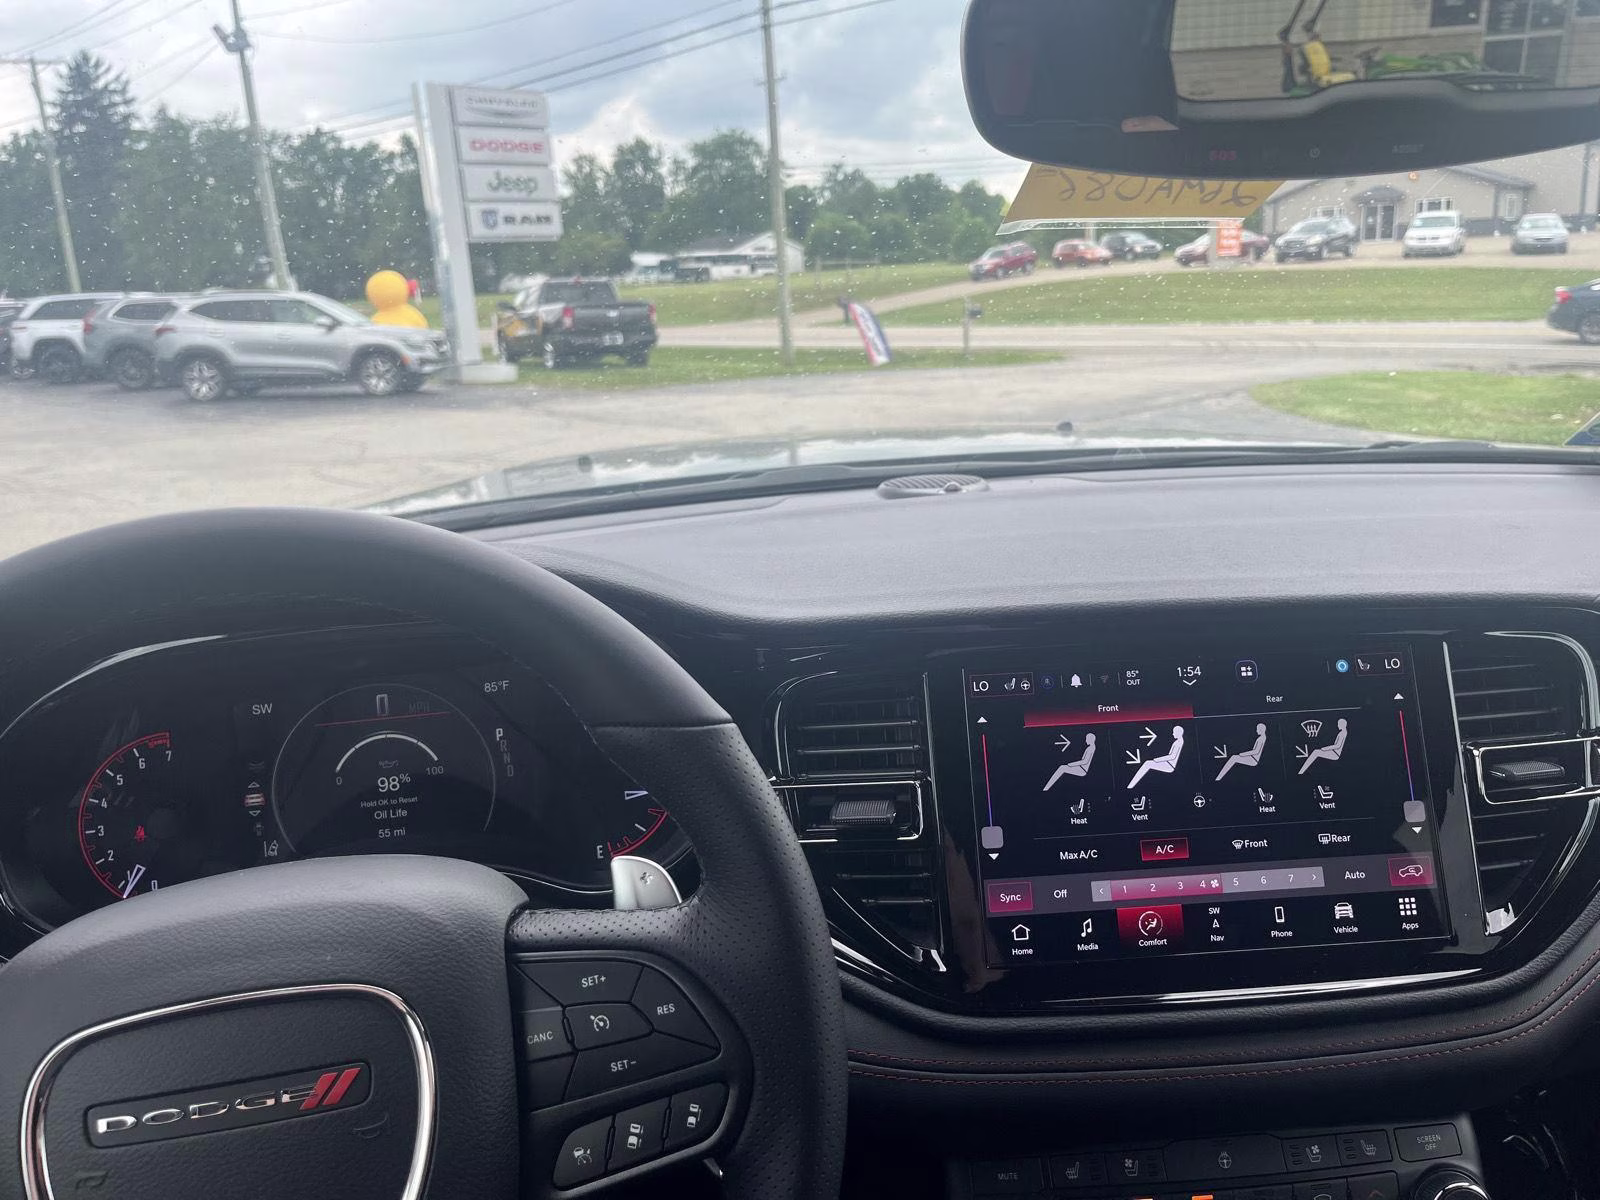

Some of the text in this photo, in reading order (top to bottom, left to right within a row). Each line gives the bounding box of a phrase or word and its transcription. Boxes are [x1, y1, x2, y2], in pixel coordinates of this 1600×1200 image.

[470, 139, 544, 153] DODGE
[487, 170, 538, 196] Jeep
[503, 215, 553, 225] RAM
[1384, 658, 1401, 669] LO
[1177, 666, 1202, 677] 1:54
[484, 680, 510, 693] 85°F
[973, 680, 990, 692] LO
[1126, 678, 1141, 686] OUT
[1266, 695, 1284, 703] Rear
[252, 703, 273, 716] SW
[1097, 704, 1119, 713] Front
[166, 751, 172, 762] 7
[139, 758, 146, 769] 6
[425, 765, 444, 776] 100
[116, 774, 124, 786] 5
[336, 776, 343, 786] 0
[101, 798, 108, 809] 4
[360, 800, 377, 809] Hold
[378, 799, 389, 807] OK
[399, 796, 418, 804] Reset
[374, 808, 408, 820] Oil Life
[1259, 805, 1276, 813] Heat
[1070, 817, 1088, 825] Heat
[1132, 813, 1149, 821] Vent
[97, 826, 105, 837] 3
[378, 827, 406, 838] 55 mi
[1244, 839, 1268, 848] Front
[1331, 834, 1351, 843] Rear
[596, 845, 604, 859] E
[1060, 849, 1098, 860] Max A/C
[1155, 844, 1175, 855] A/C
[107, 850, 114, 861] 2
[1344, 870, 1366, 880] Auto
[1122, 874, 1294, 894] 1 2 3 4 5 6 7
[1000, 893, 1022, 903] Sync
[1053, 889, 1068, 898] Off
[1208, 907, 1221, 915] SW
[1333, 925, 1359, 934] Vehicle
[1402, 922, 1419, 930] Apps
[1210, 934, 1225, 942] Nav
[1271, 930, 1293, 938] Phone
[1077, 942, 1099, 951] Media
[1138, 938, 1168, 947] Comfort
[1012, 947, 1034, 955] Home
[656, 1003, 676, 1016] RES
[527, 1031, 554, 1044] CANC
[97, 1086, 320, 1133] DODGE
[1416, 1134, 1441, 1144] SCREEN
[1425, 1143, 1437, 1151] OFF
[998, 1172, 1019, 1181] MUTE
